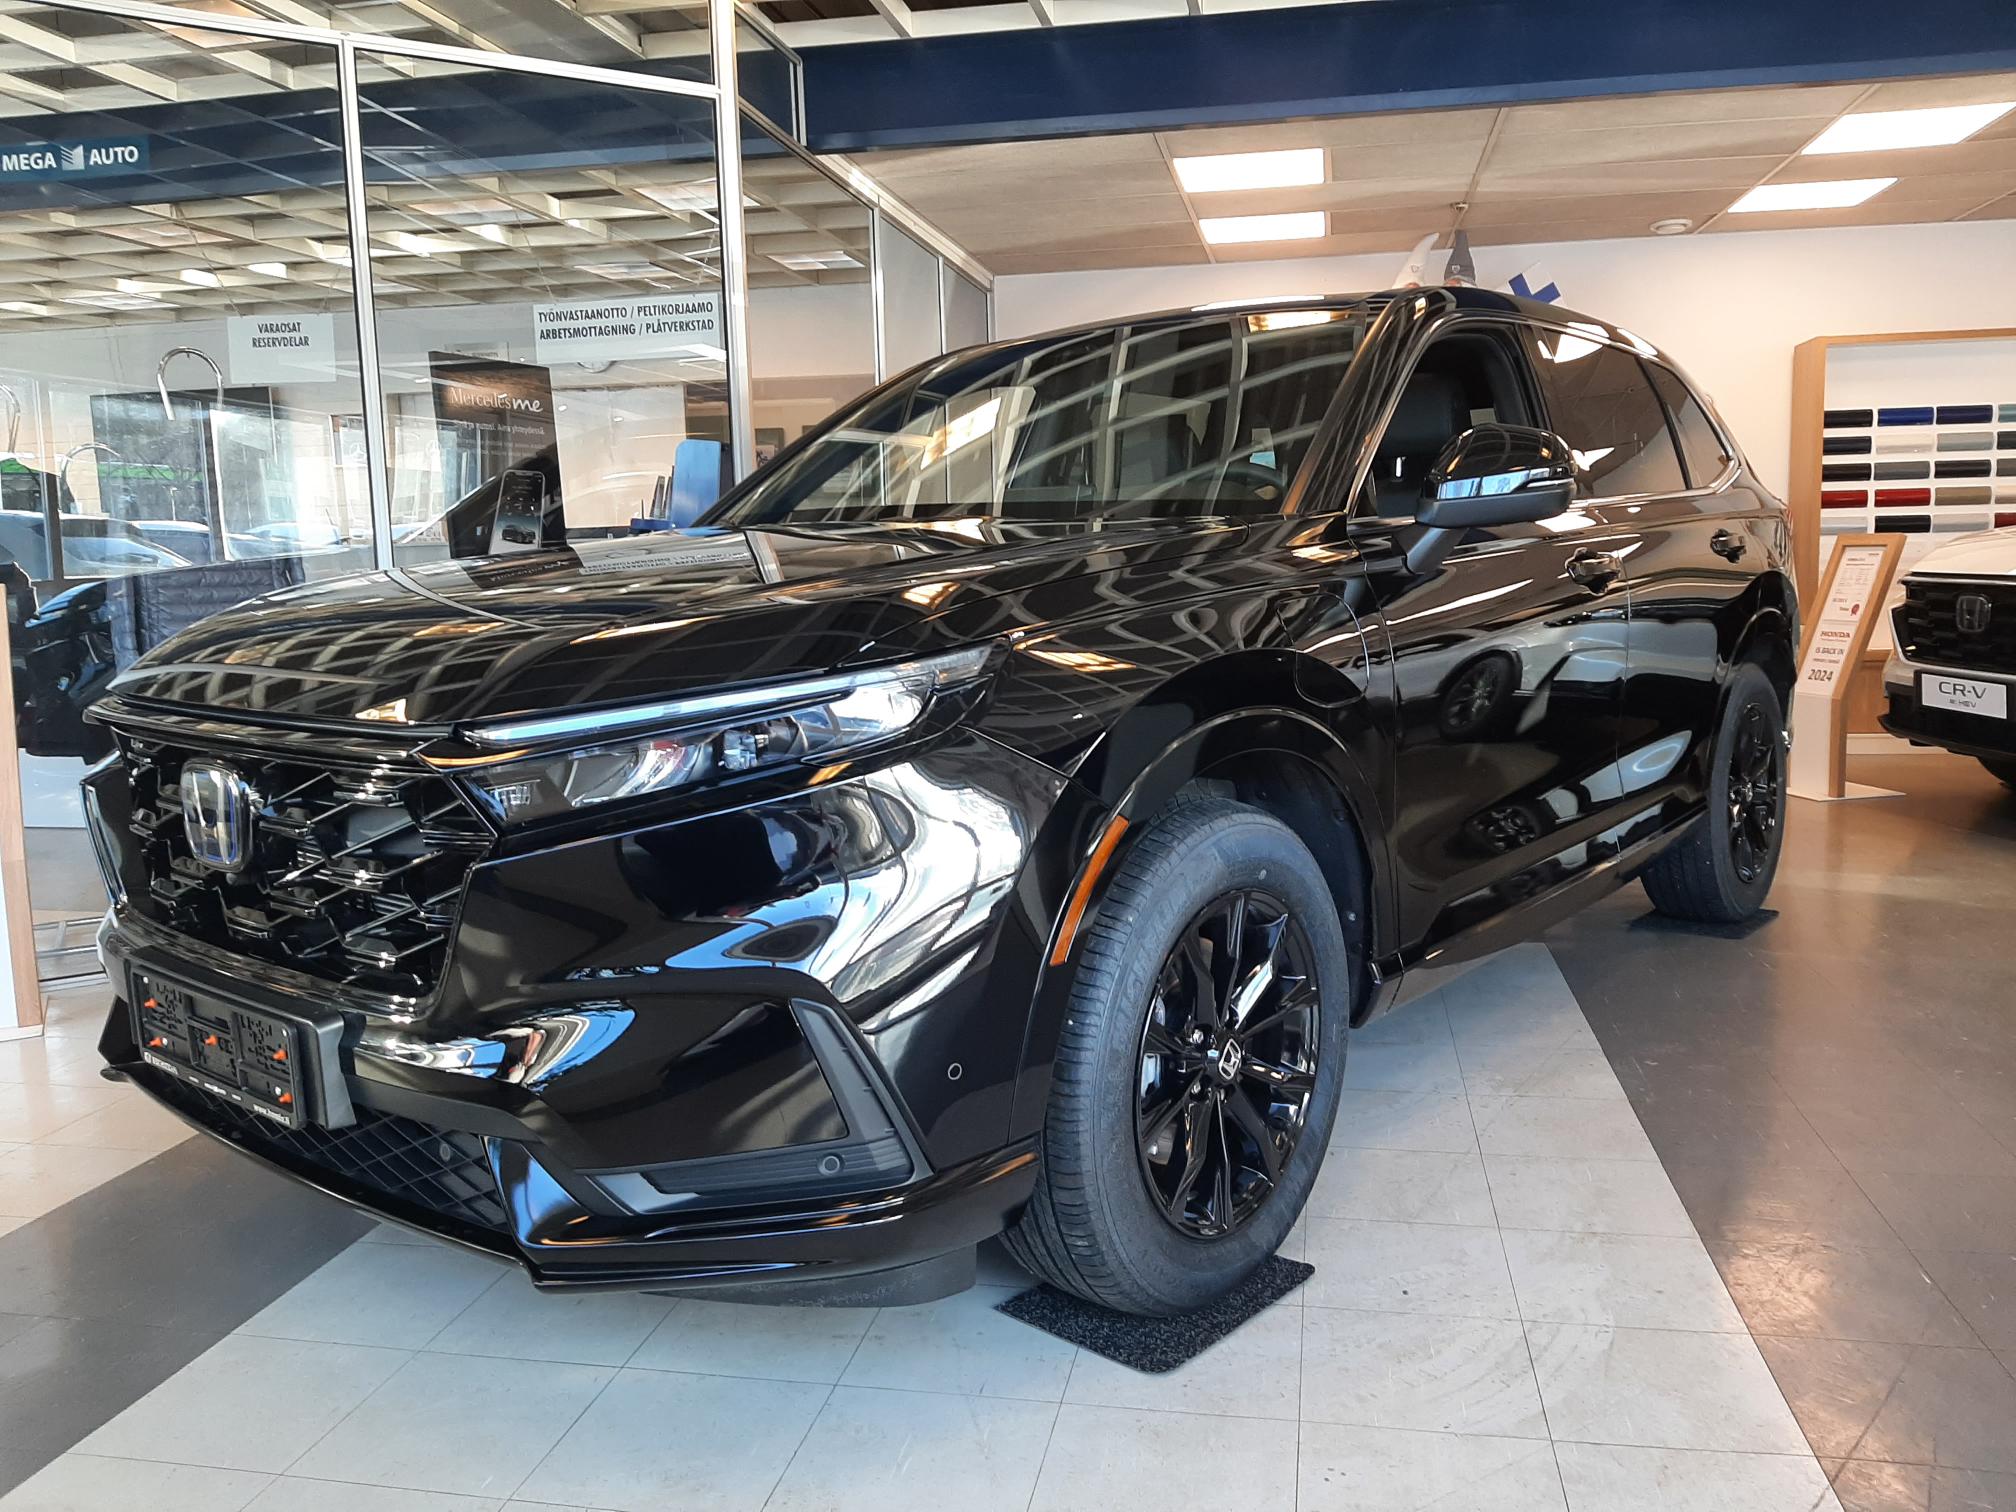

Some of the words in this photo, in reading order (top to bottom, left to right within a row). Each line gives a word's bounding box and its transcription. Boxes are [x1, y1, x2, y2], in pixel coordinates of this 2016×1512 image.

[2, 152, 57, 172] MEGA
[89, 145, 139, 166] AUTO
[538, 307, 627, 323] TYÖNVASTAANOTTO
[637, 302, 713, 317] PELTIKORJAAMO
[257, 321, 302, 334] VARAOSAT
[539, 324, 636, 340] ARBETSMOTTAGNING
[646, 318, 714, 335] PLÅTVERKSTAD
[252, 336, 310, 348] RESERVDELAR
[512, 397, 544, 413] me
[1808, 669, 1834, 682] 2024
[1938, 681, 1987, 699] CR-V
